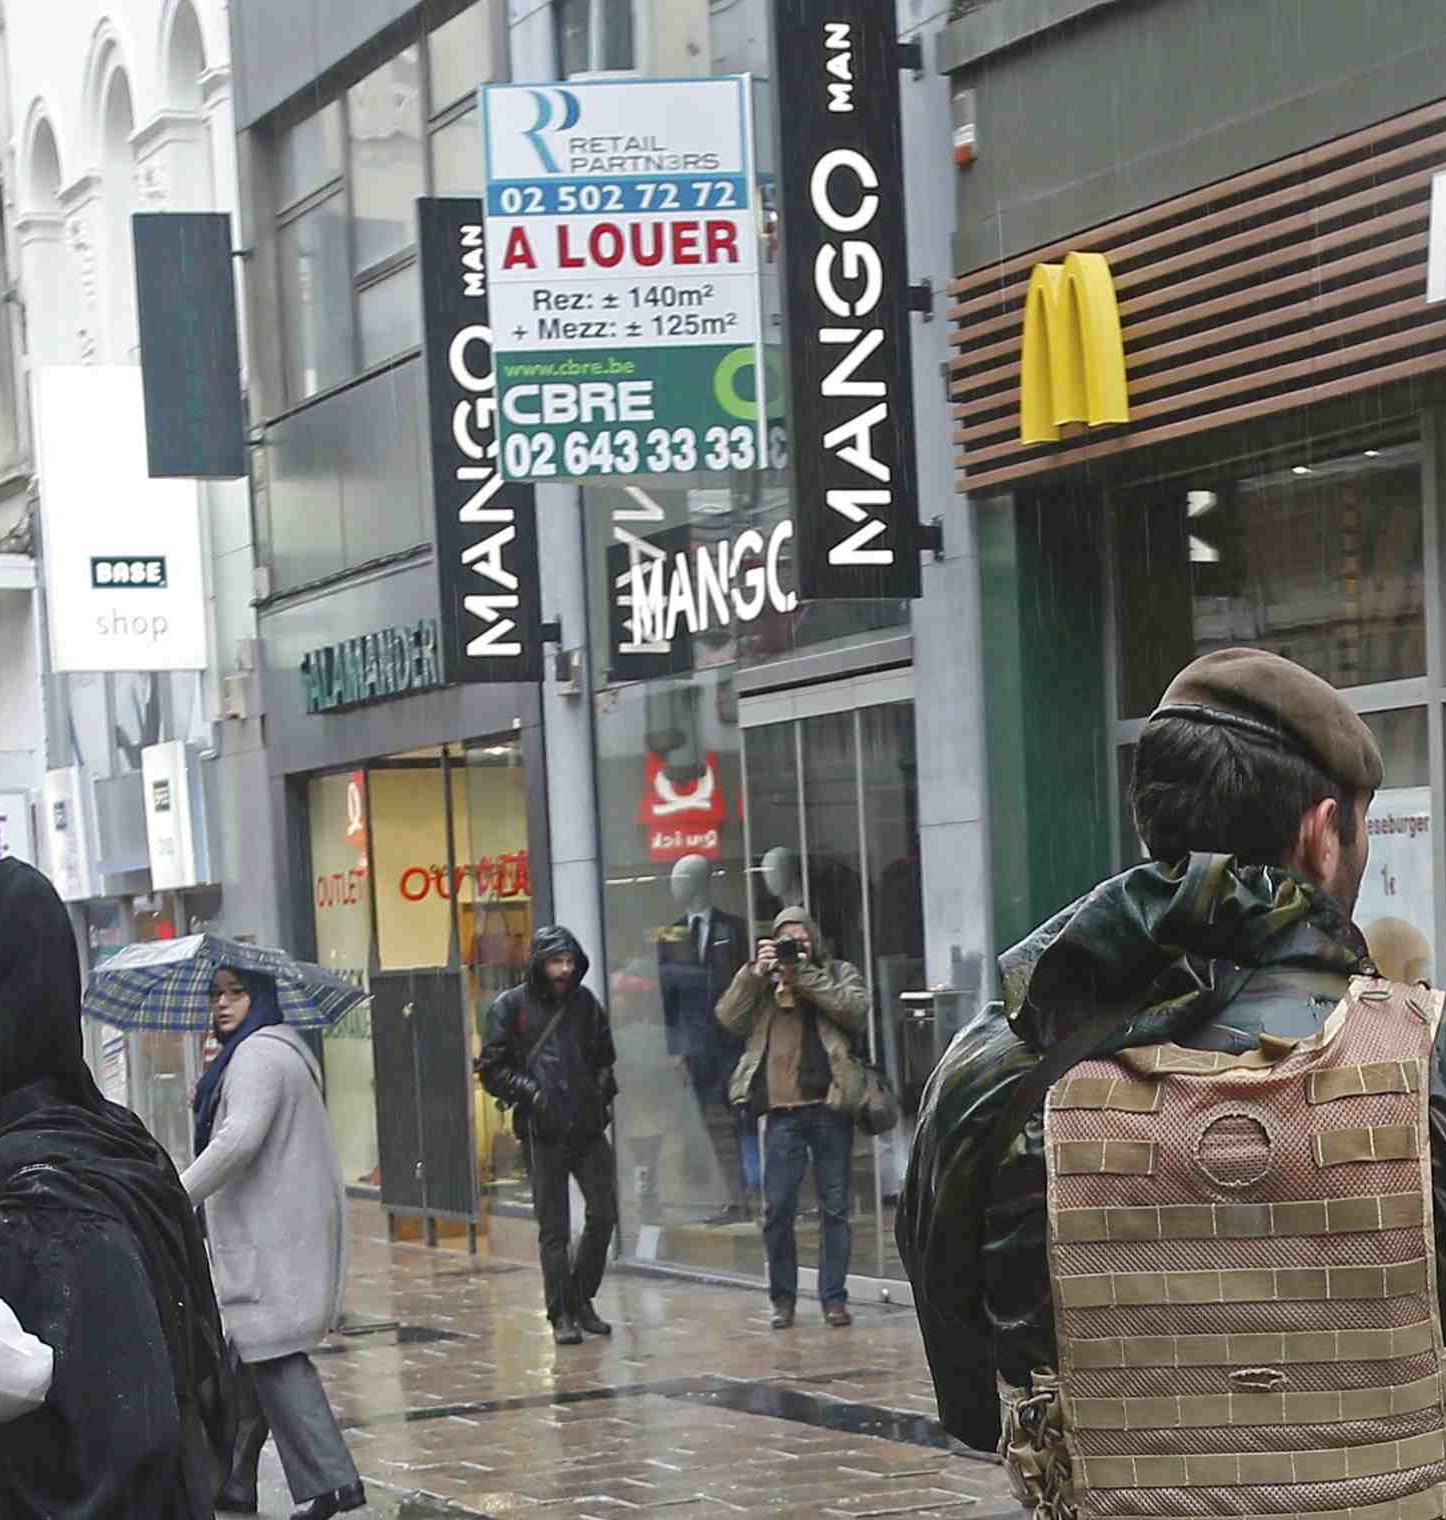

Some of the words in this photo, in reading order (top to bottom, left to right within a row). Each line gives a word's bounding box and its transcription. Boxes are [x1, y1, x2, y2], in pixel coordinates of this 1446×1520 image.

[823, 22, 854, 112] MAN
[569, 134, 667, 155] RETAIL
[569, 152, 722, 174] PARTN3RS
[500, 186, 545, 214] 02
[556, 184, 625, 212] 502
[634, 182, 681, 210] 72
[690, 180, 737, 208] 72
[459, 224, 485, 297] MAN
[501, 225, 538, 270] A
[556, 218, 740, 269] LOUER
[532, 287, 594, 312] Rez:
[538, 316, 617, 340] Mezz:
[504, 356, 636, 378] www.cbre.be
[809, 148, 895, 566] MANGO
[502, 379, 655, 426] CBRE
[504, 430, 557, 479] 02
[563, 428, 640, 476] 643
[645, 426, 697, 473] 33
[704, 424, 756, 471] 33
[449, 324, 523, 657] MANGO
[95, 560, 163, 585] BASE
[94, 608, 170, 642] shop
